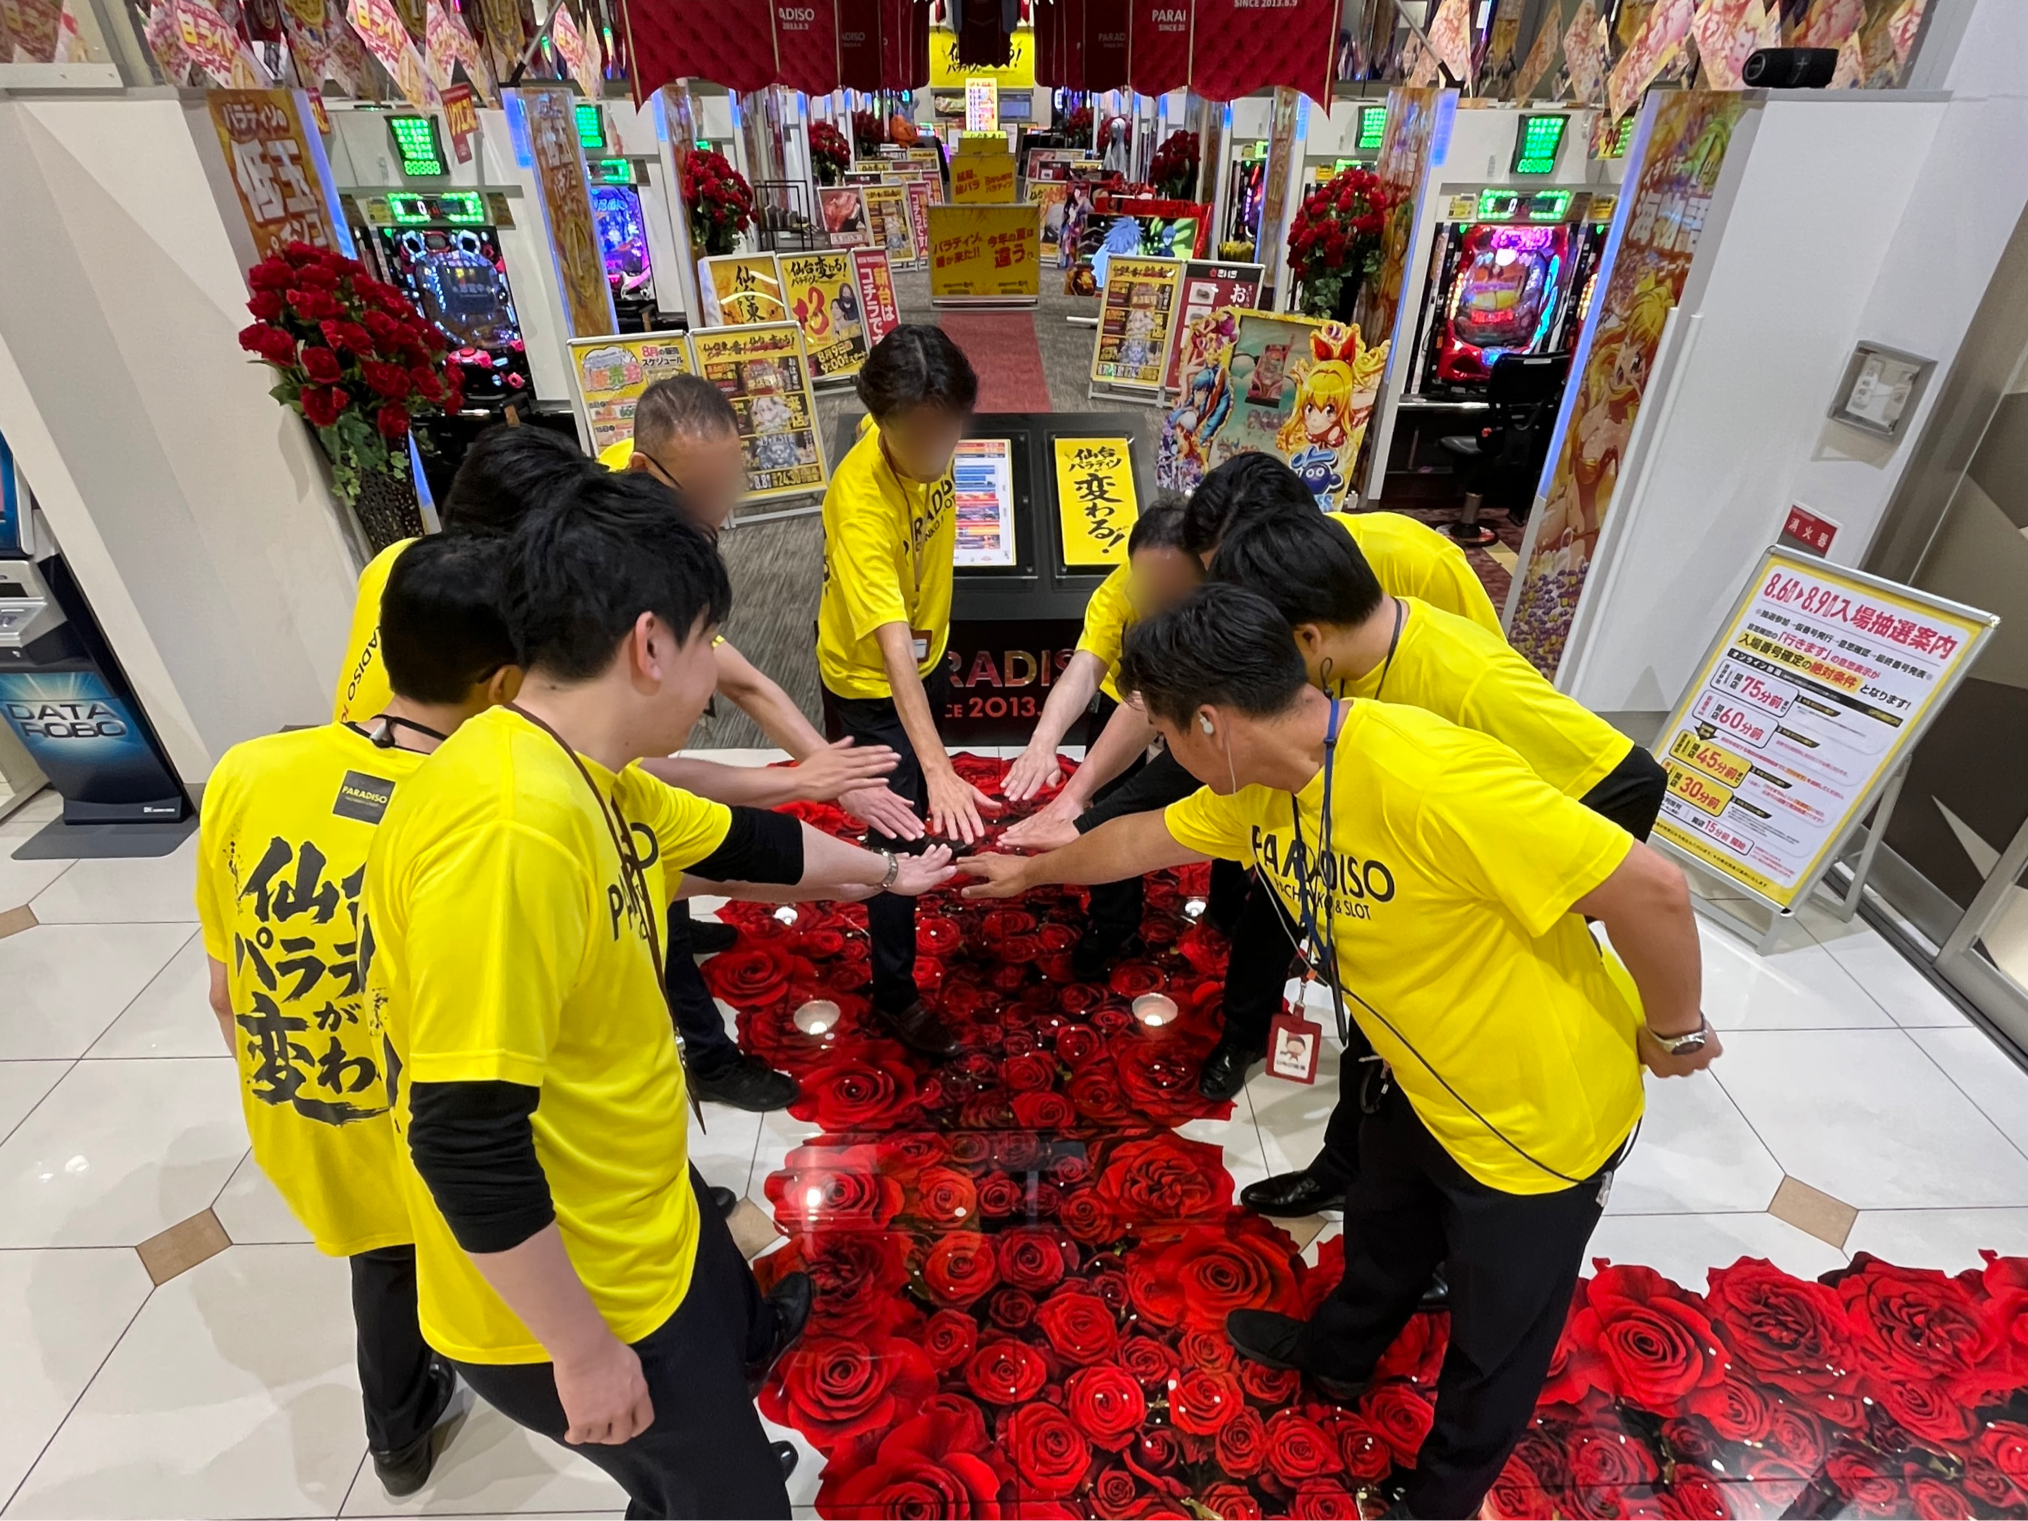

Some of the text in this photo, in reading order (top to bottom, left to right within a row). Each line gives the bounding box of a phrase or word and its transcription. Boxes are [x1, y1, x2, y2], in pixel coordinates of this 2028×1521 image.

[641, 356, 684, 367] スケジュール
[1068, 457, 1122, 473] パラディソ
[1074, 446, 1116, 462] 仙台
[1830, 597, 1959, 660] 入場抽選案内
[1740, 675, 1785, 709] 75分前
[6, 703, 117, 721] DATA
[1718, 707, 1765, 741] 60分前
[20, 721, 128, 739] ROBO
[1696, 747, 1739, 781] 45分前
[341, 785, 388, 804] PARADISO
[1679, 775, 1722, 811] 30分前
[1251, 824, 1396, 903] PARDISO
[1344, 902, 1372, 921] SLOT
[313, 1001, 362, 1032] が
